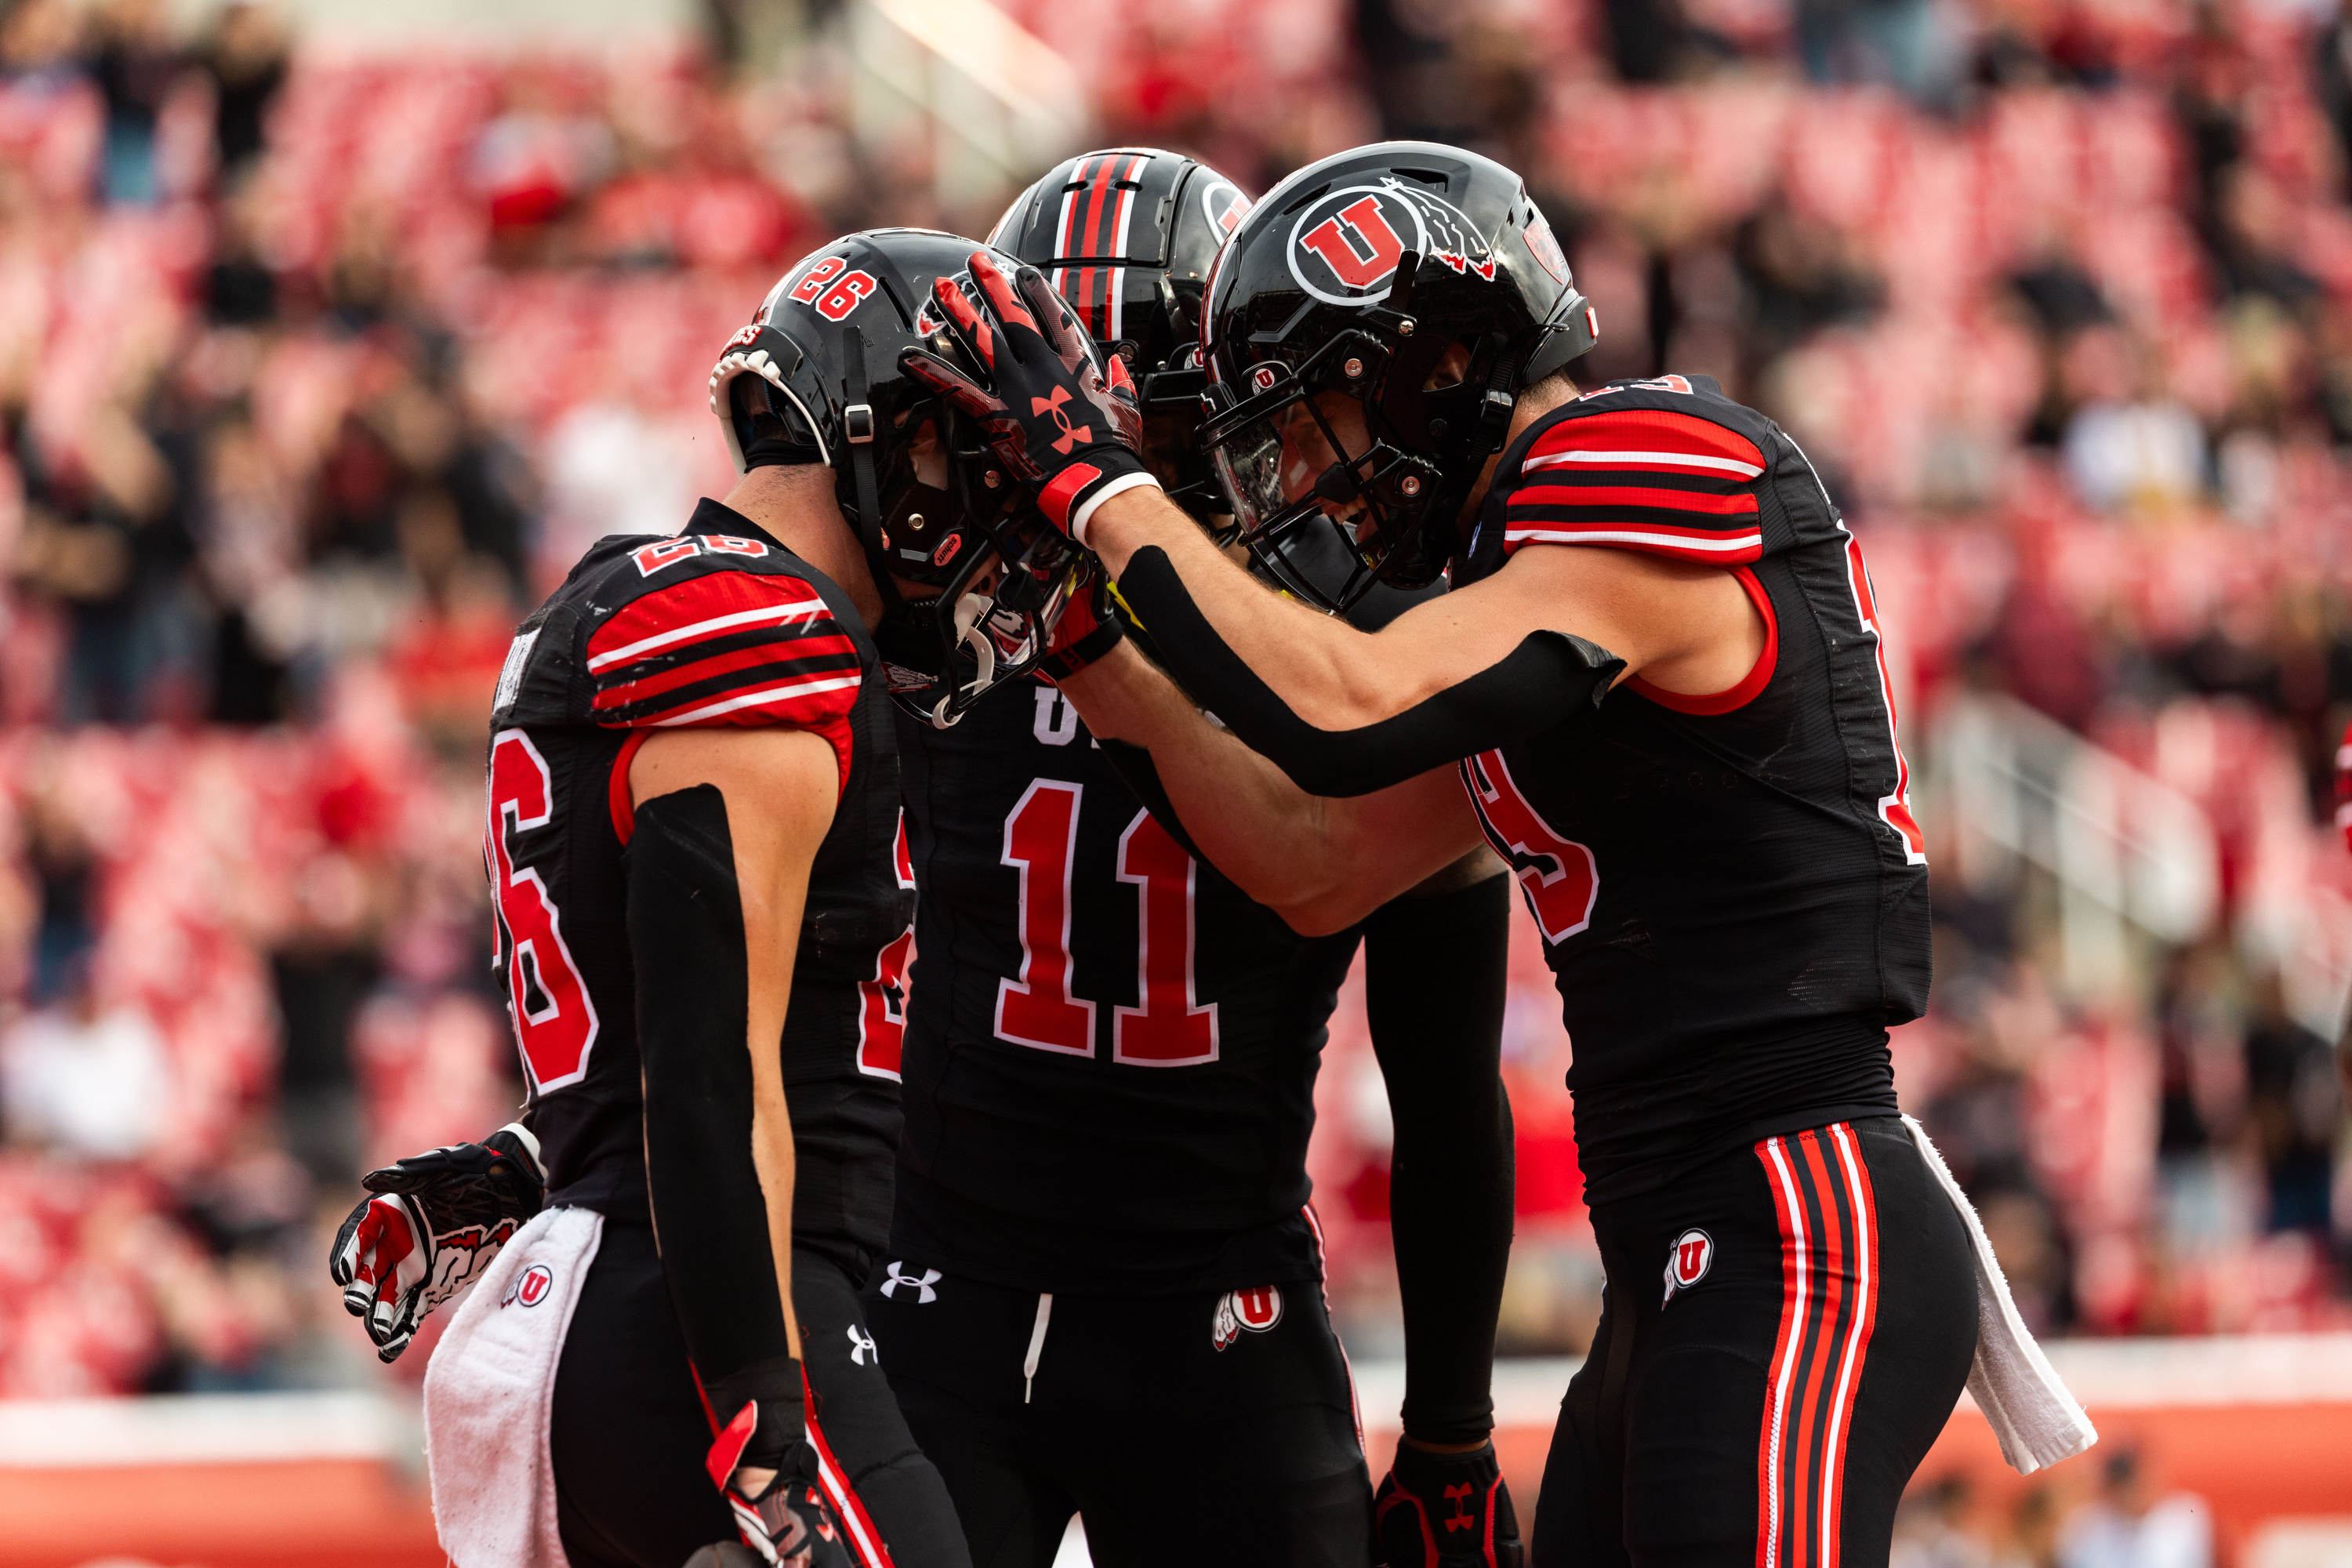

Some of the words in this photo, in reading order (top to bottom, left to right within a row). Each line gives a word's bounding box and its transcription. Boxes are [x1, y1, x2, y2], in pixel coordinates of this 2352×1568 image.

[1298, 194, 1405, 290] U
[787, 256, 877, 321] 26
[1256, 369, 1273, 388] U
[993, 777, 1220, 1068] 11
[1679, 1240, 1706, 1282] U
[521, 1271, 548, 1303] U
[1236, 1286, 1274, 1324] U
